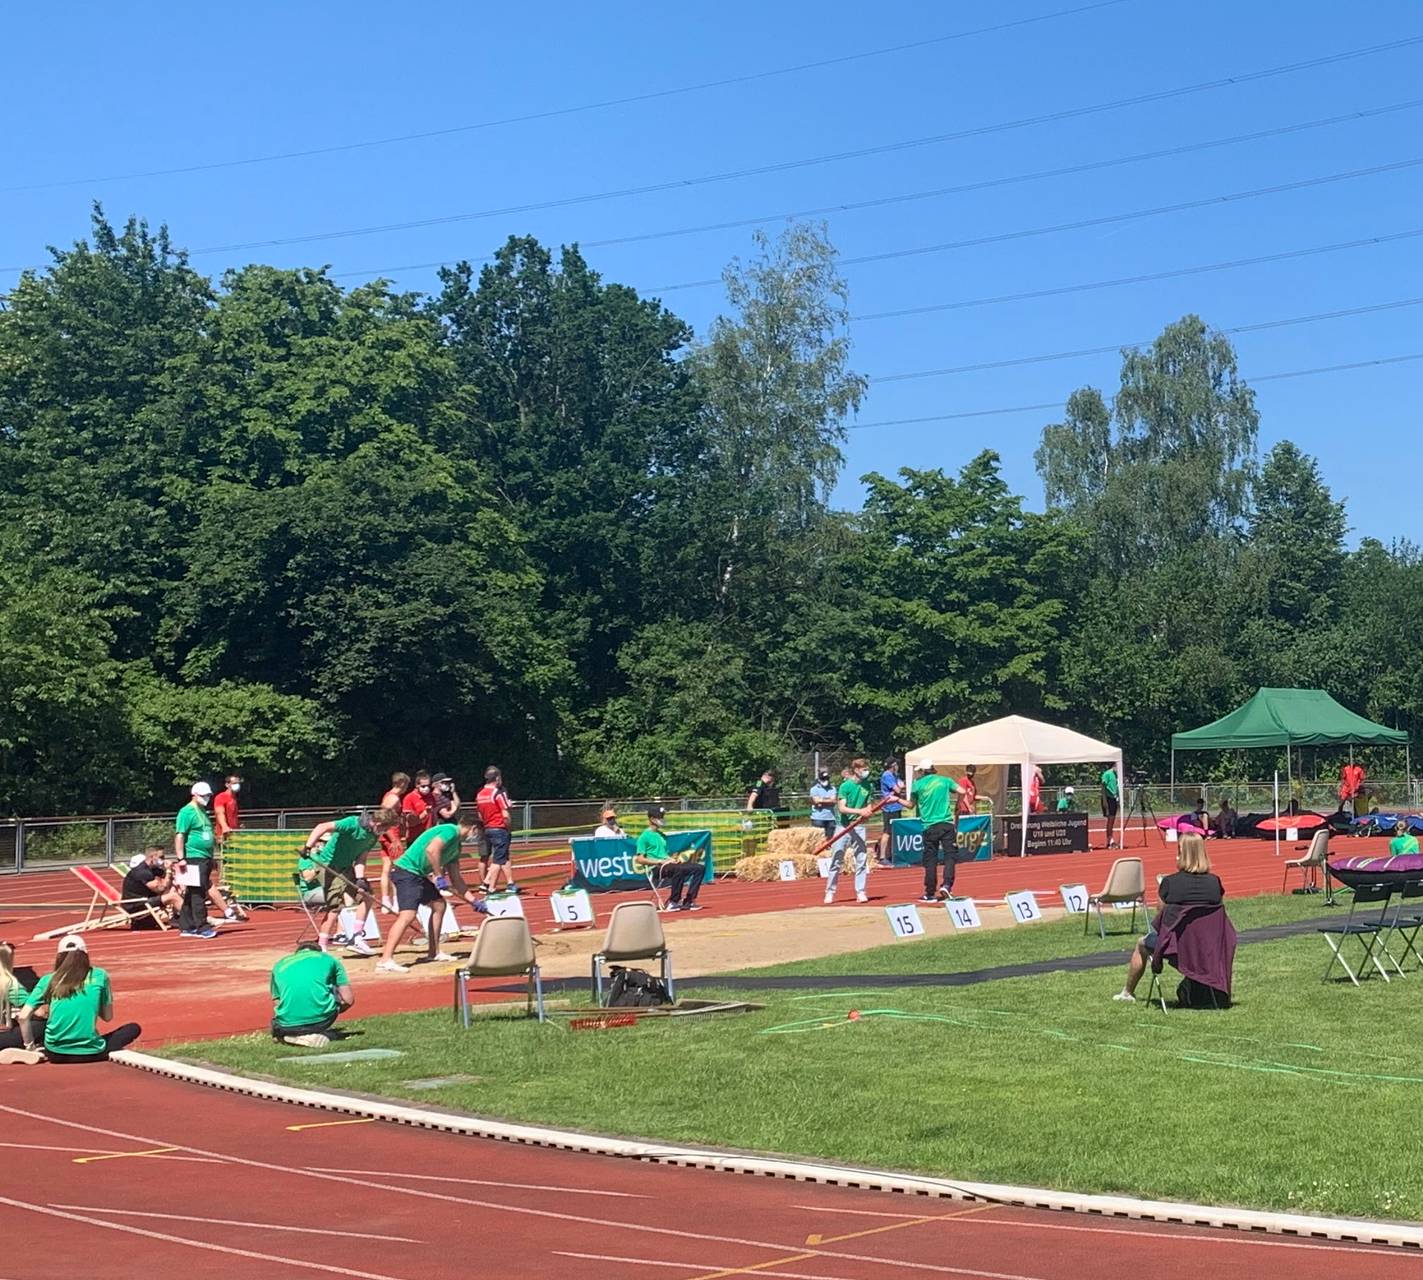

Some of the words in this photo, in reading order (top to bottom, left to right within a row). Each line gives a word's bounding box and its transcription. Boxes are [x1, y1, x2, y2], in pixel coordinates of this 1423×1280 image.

[1027, 840, 1047, 849] Beginn
[1062, 838, 1072, 846] Uhr
[1016, 901, 1034, 920] 13
[1068, 895, 1086, 912] 12
[567, 905, 578, 921] 5
[955, 908, 973, 927] 14
[896, 915, 915, 935] 15
